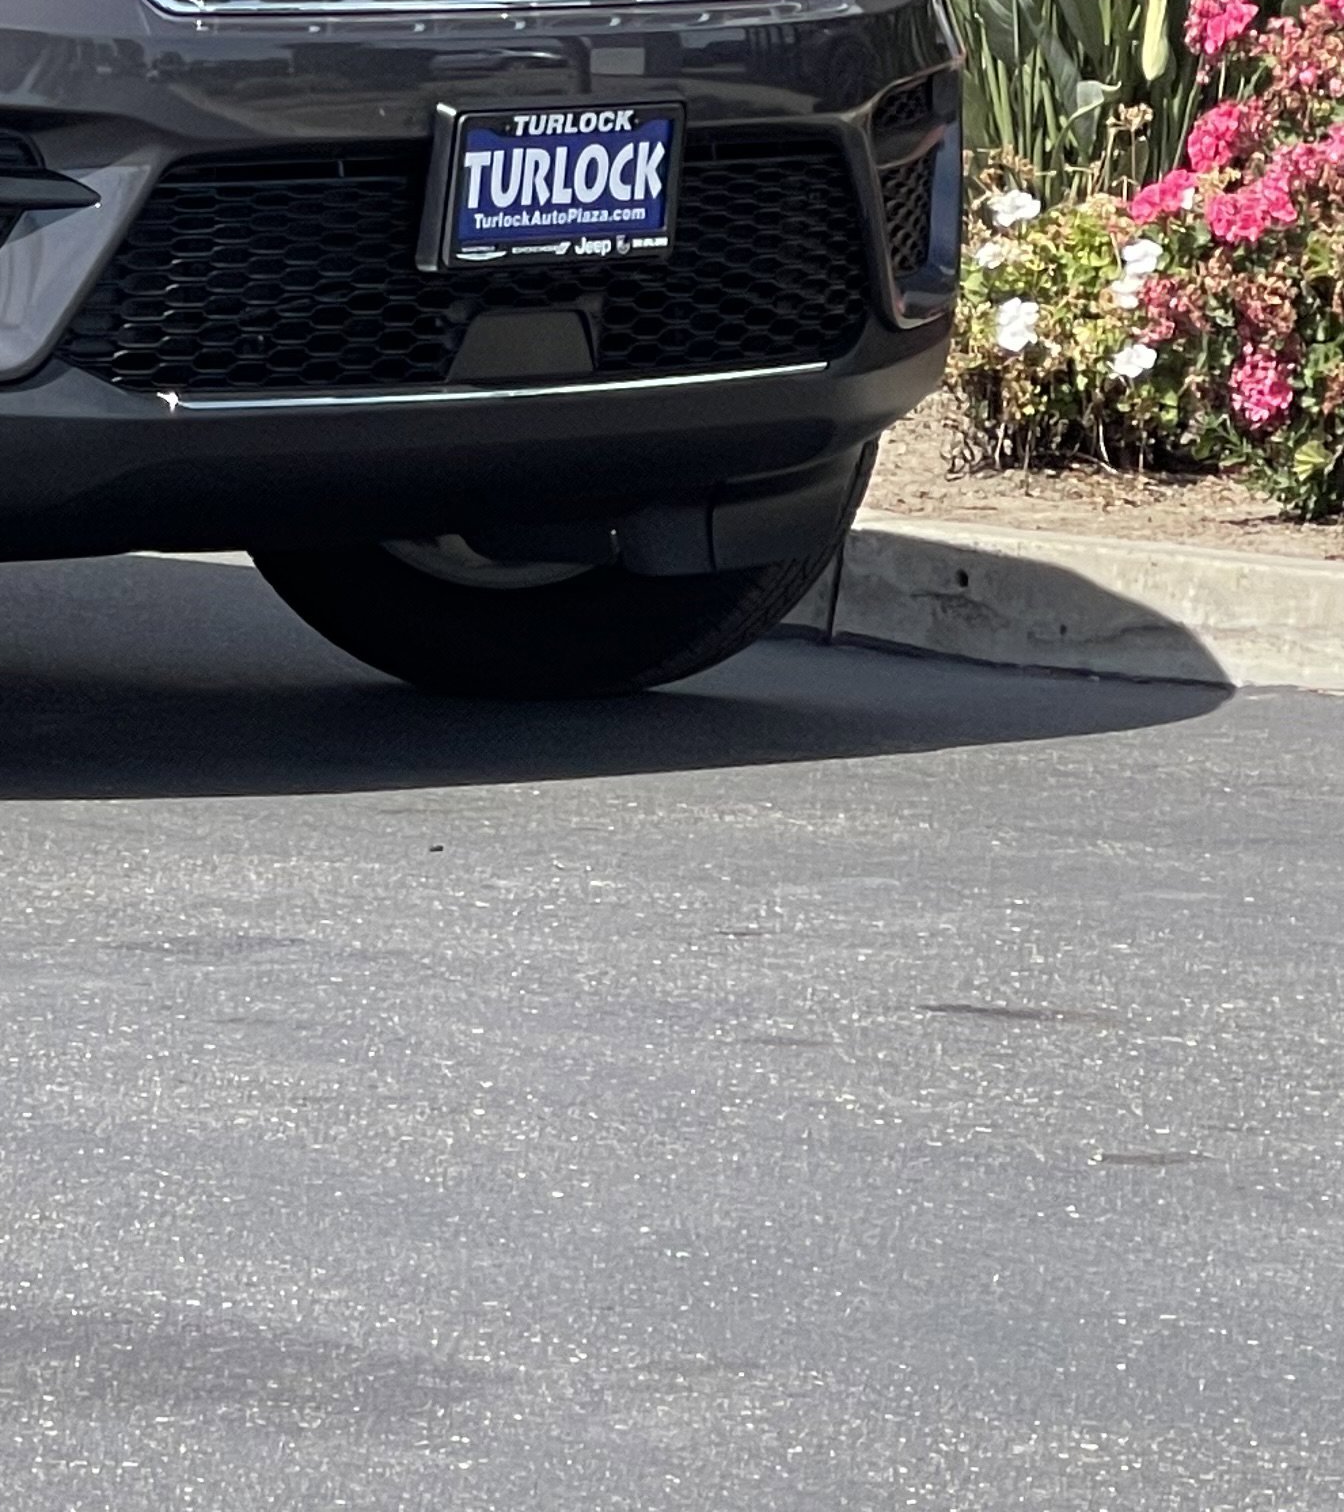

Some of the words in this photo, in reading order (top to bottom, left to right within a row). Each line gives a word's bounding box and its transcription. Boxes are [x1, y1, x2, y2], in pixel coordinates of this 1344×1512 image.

[513, 110, 635, 136] TURLOCK
[464, 140, 666, 210] TURLOCK
[474, 207, 646, 230] TurlockAutoPlaza.com
[574, 236, 612, 257] Jeep
